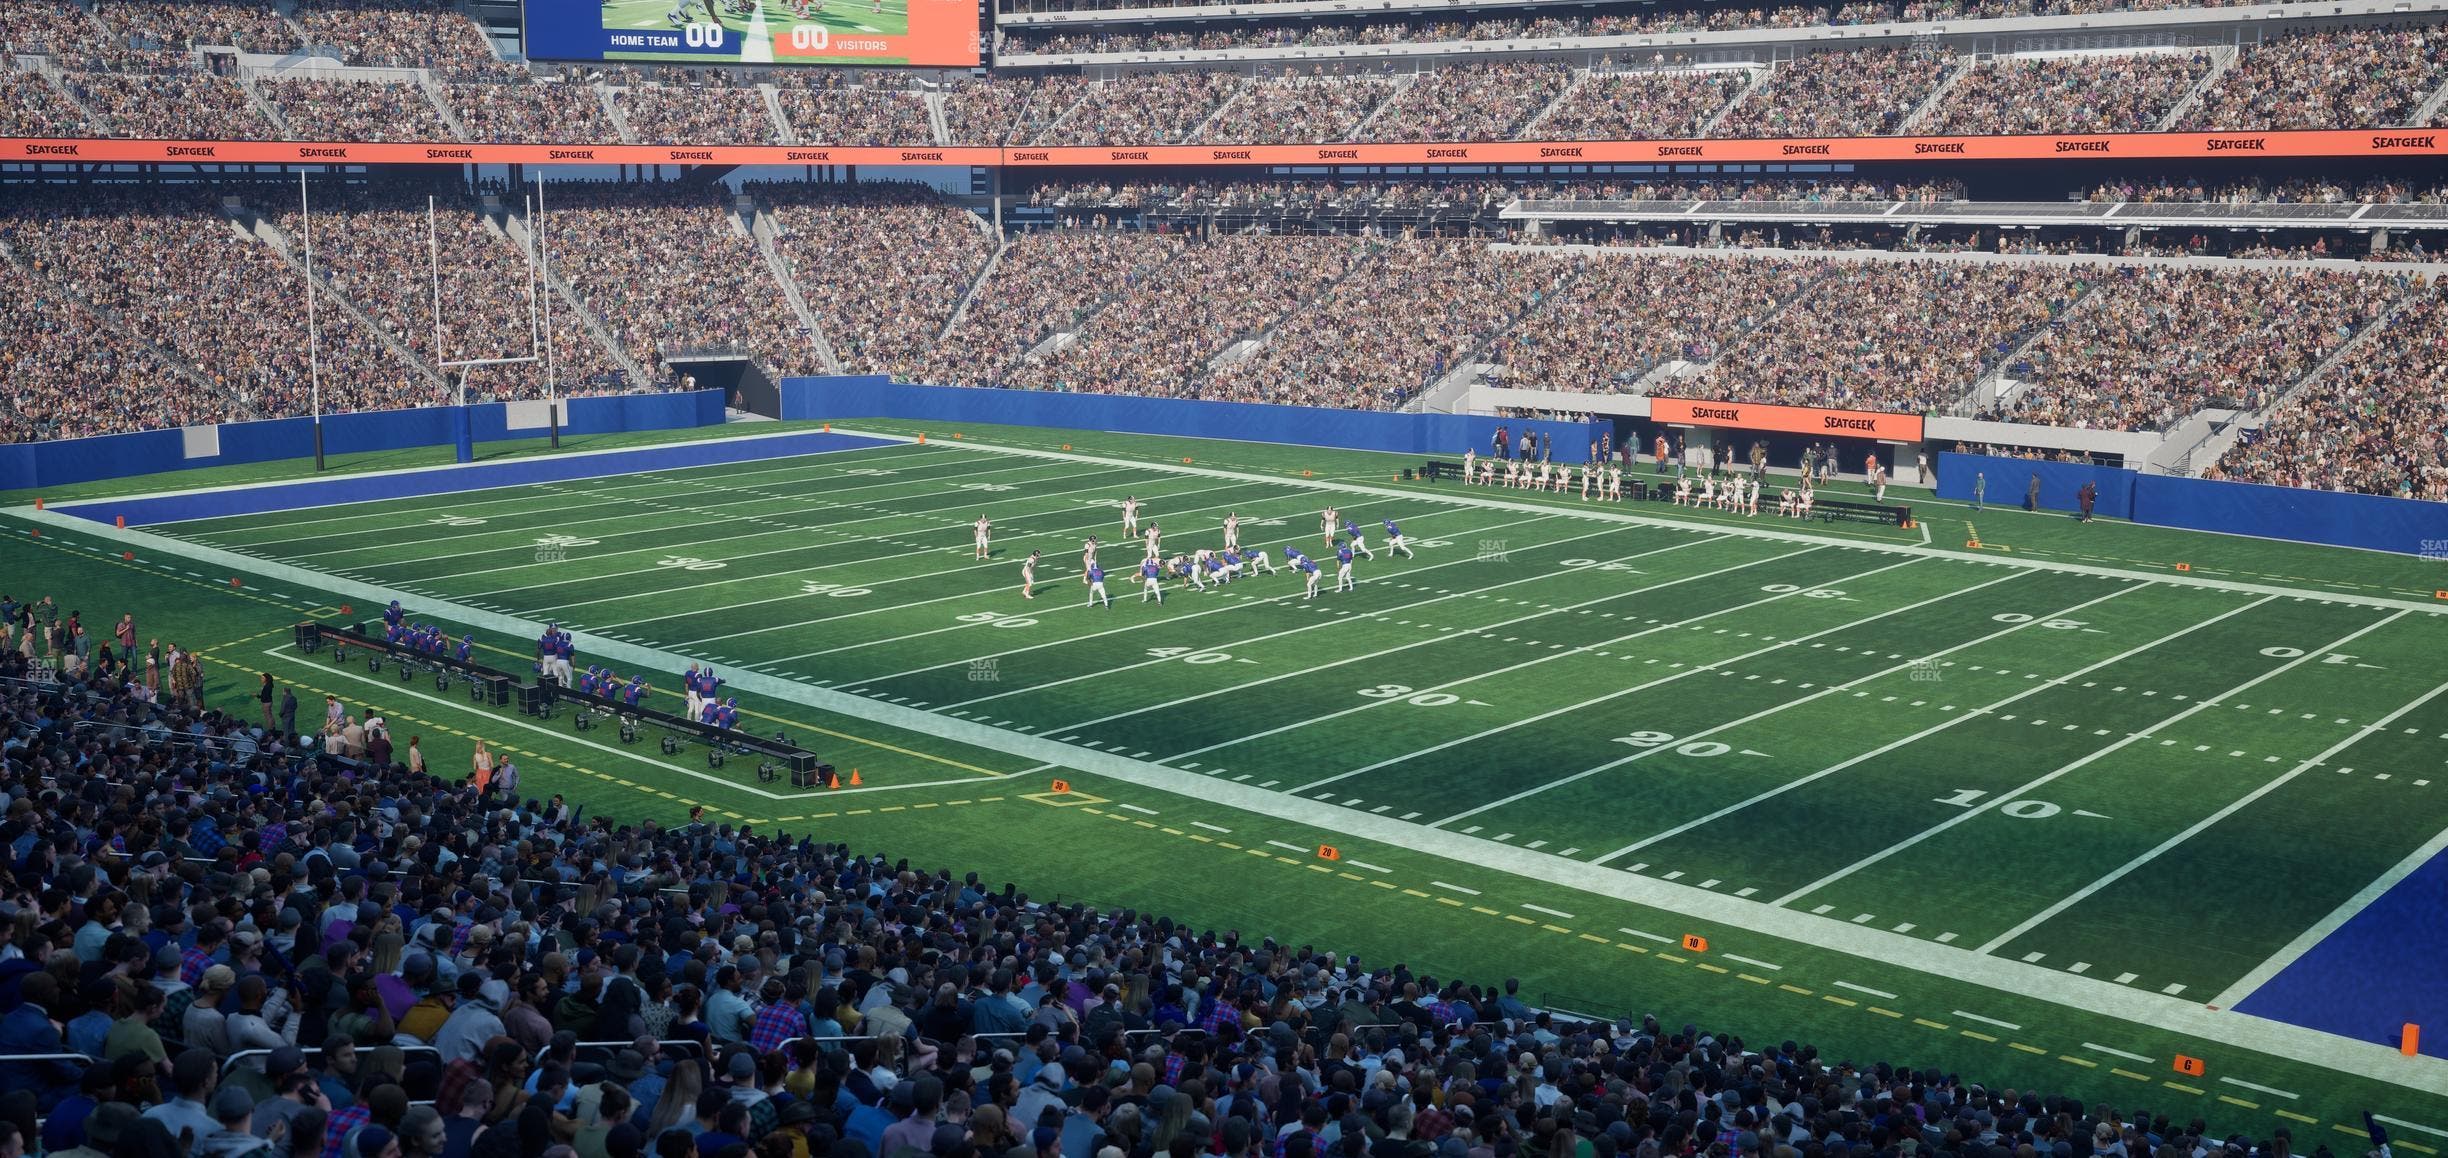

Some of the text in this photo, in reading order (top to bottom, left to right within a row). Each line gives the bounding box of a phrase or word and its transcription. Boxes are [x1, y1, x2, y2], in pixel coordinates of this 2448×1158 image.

[611, 22, 723, 48] HOME TEAM 00
[791, 24, 888, 51] 00 VISITORS
[2055, 140, 2110, 153] SEATGEEK
[2206, 138, 2265, 151] SEATGEEK
[2372, 135, 2435, 149] SEATGEEK
[25, 144, 79, 156] SEATGEEK
[166, 146, 215, 157] SEATGEEK
[299, 147, 347, 158] SEATGEEK
[1426, 148, 1468, 159] SEATGEEK
[1540, 147, 1583, 158] SEATGEEK
[1658, 146, 1703, 157] SEATGEEK
[1782, 144, 1830, 155] SEATGEEK
[1914, 142, 1965, 154] SEATGEEK
[426, 149, 473, 159] SEATGEEK
[549, 150, 594, 160] SEATGEEK
[670, 151, 713, 160] SEATGEEK
[787, 151, 829, 161] SEATGEEK
[901, 152, 943, 161] SEATGEEK
[1013, 152, 1049, 161] SEATGEEK
[1111, 151, 1148, 160] SEATGEEK
[1213, 151, 1251, 160] SEATGEEK
[1318, 150, 1358, 159] SEATGEEK
[1692, 406, 1739, 422] SEATGEEK
[1824, 416, 1876, 432] SEATGEEK
[955, 611, 1039, 628] 50
[1145, 646, 1233, 664] 40
[1356, 684, 1460, 707] 30
[1609, 730, 1731, 757] 20
[1932, 788, 2062, 819] 10
[1322, 847, 1332, 857] 20
[1689, 937, 1699, 948] 10
[2184, 1059, 2192, 1071] G
